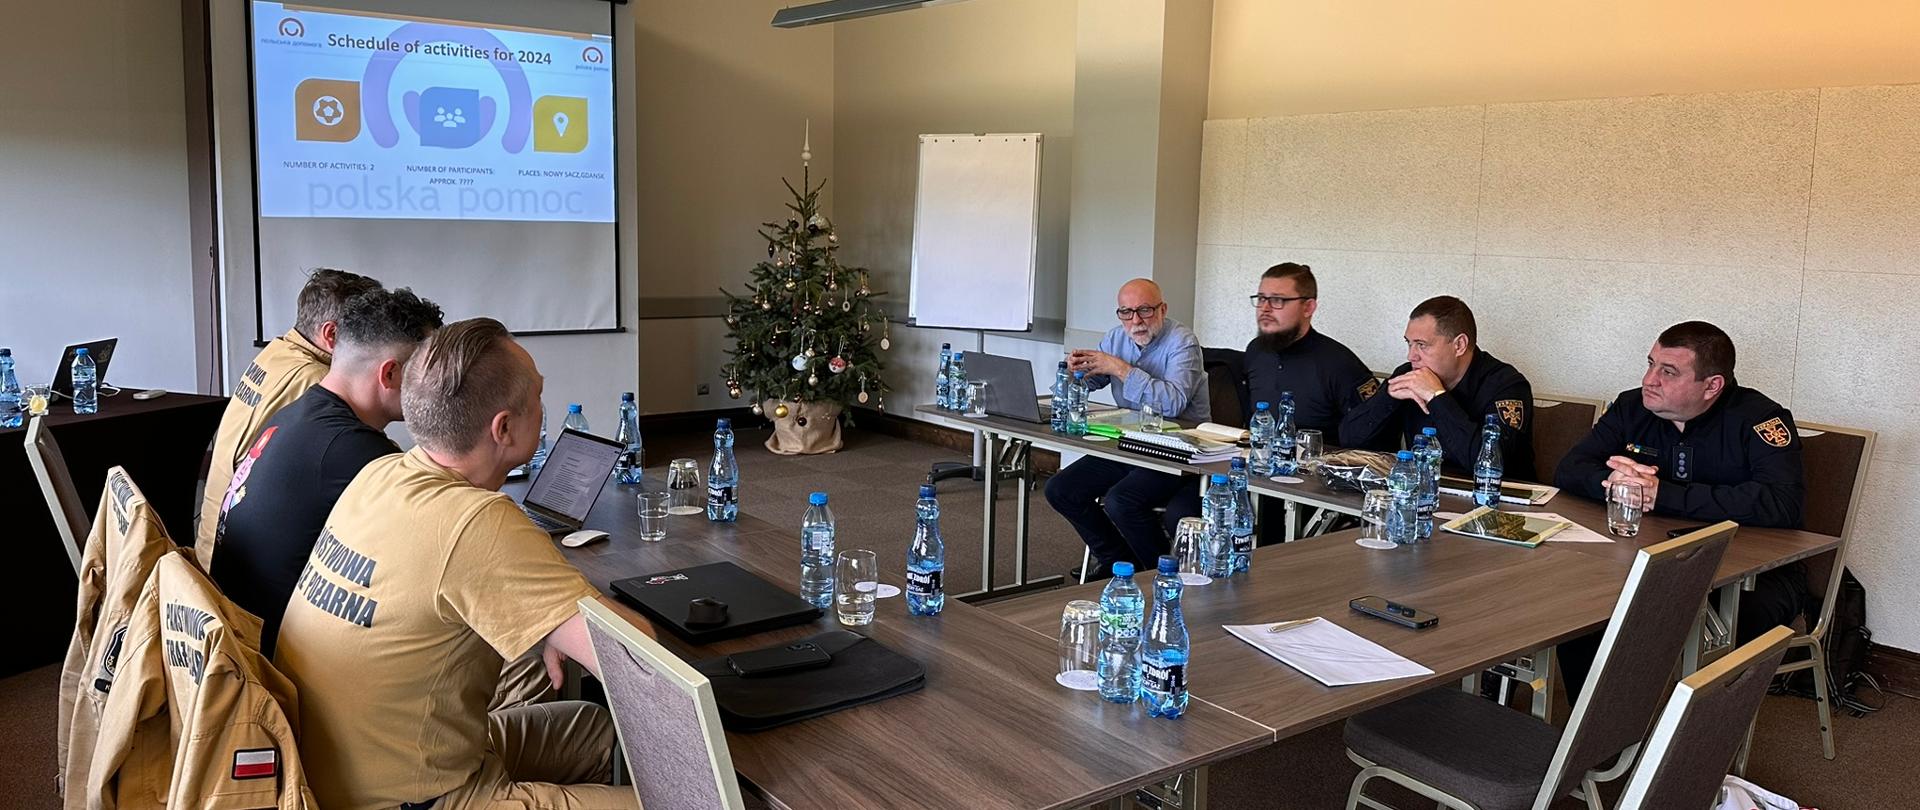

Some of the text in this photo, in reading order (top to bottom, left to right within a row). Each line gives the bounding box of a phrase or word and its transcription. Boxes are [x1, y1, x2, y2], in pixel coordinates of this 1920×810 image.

[327, 33, 552, 65] Schedule of activities for 2024
[283, 160, 318, 169] NUMBER
[318, 161, 328, 169] OF
[406, 165, 437, 173] NUMBER
[543, 170, 564, 178] NOWY
[307, 174, 584, 219] polska pomoc
[303, 571, 378, 629] POŻARNA
[166, 639, 189, 668] TRAŻ
[1148, 666, 1169, 681] ZDRÓJ
